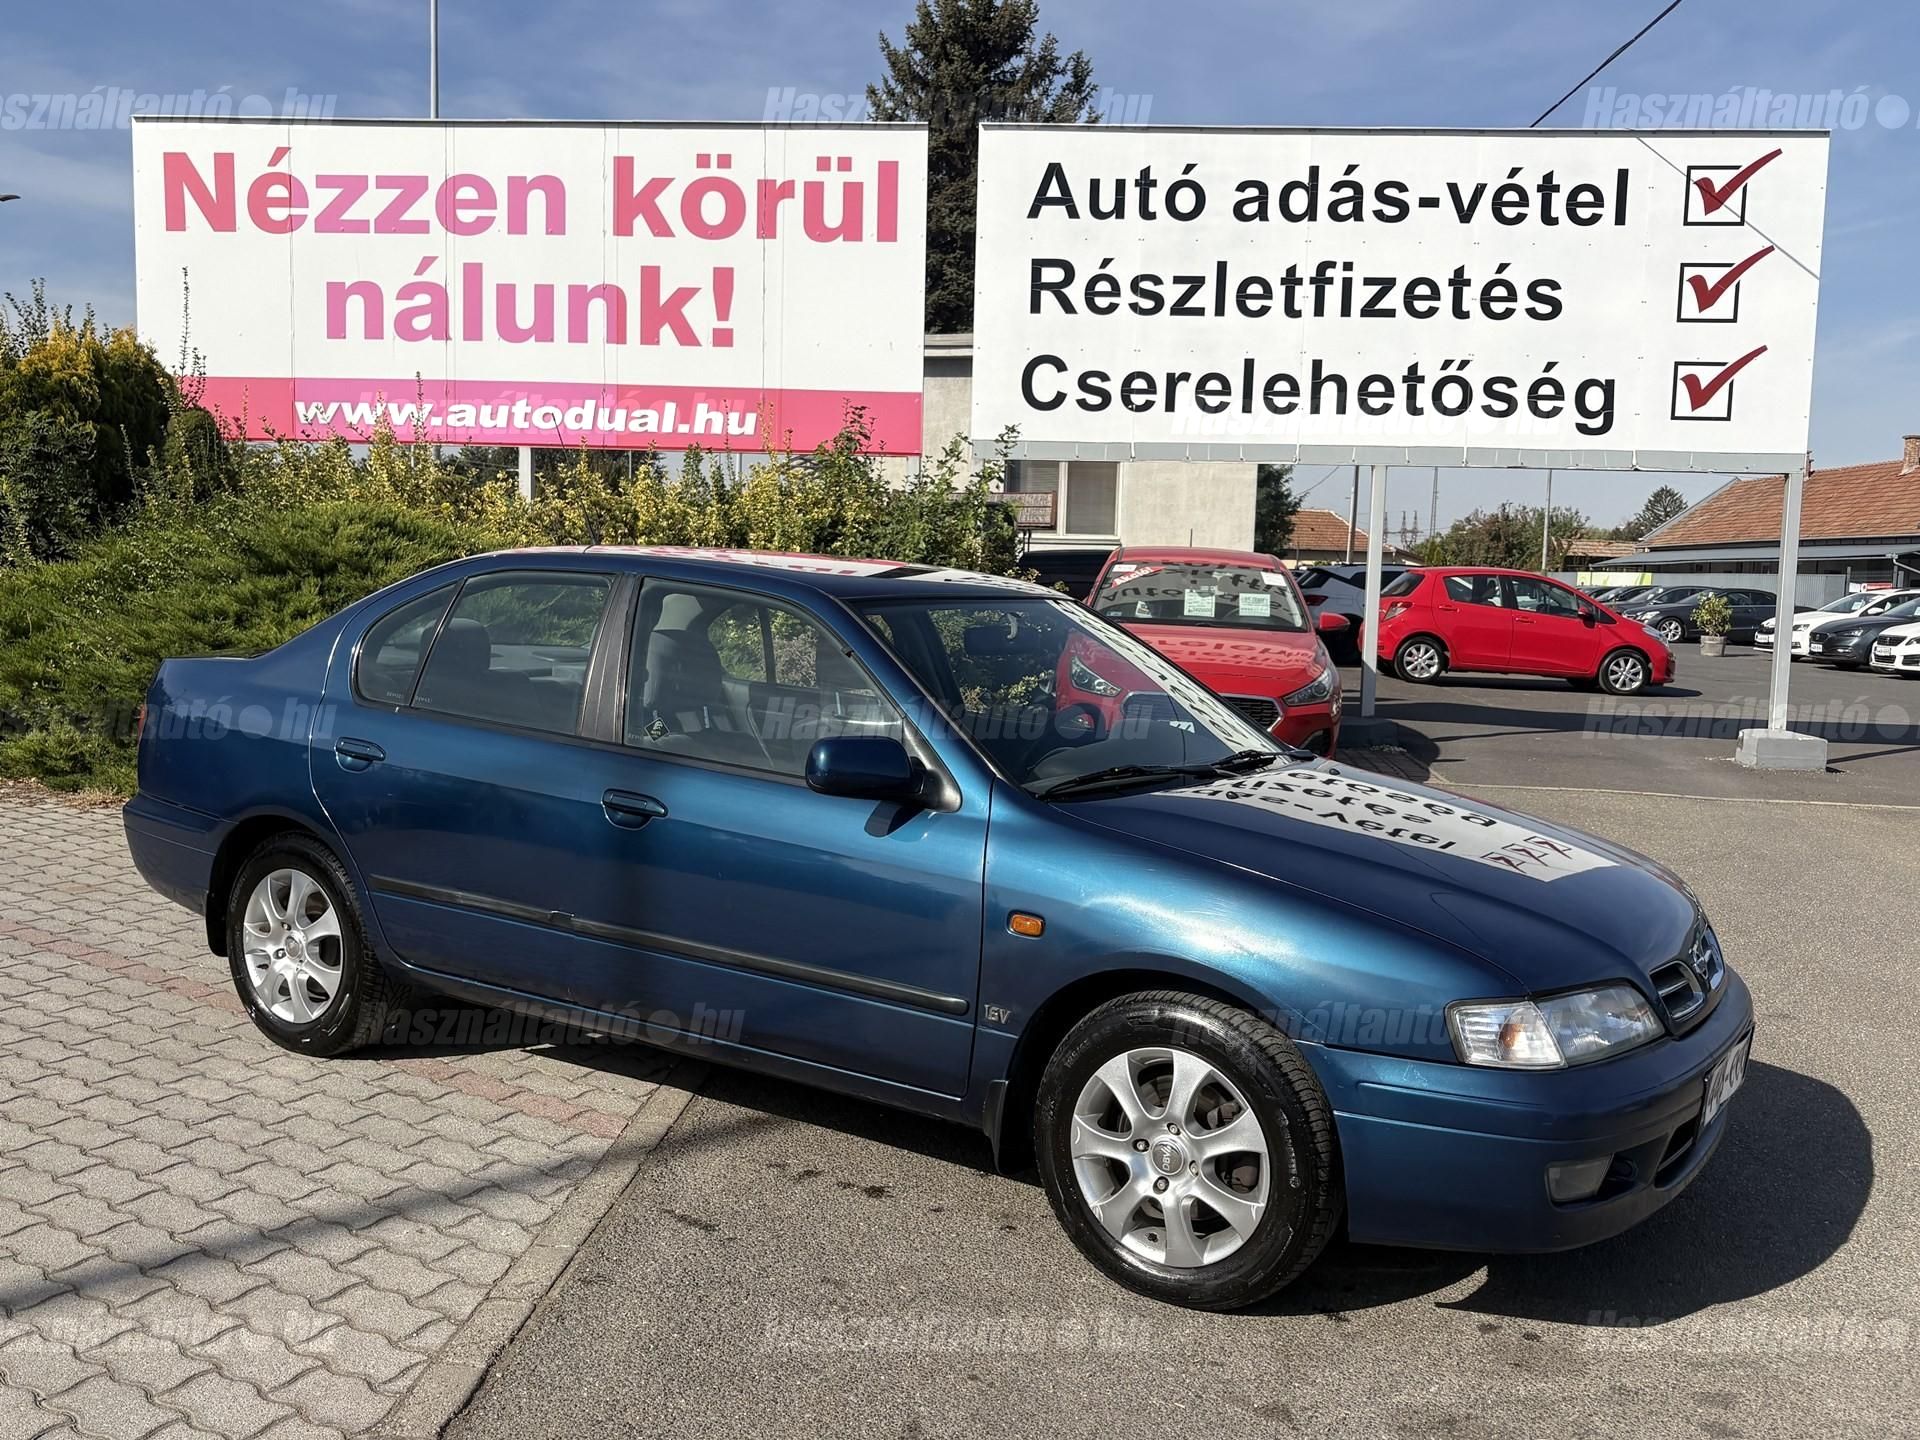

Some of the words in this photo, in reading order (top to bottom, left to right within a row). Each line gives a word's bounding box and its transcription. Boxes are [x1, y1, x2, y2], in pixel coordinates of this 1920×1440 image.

[163, 147, 566, 236] Nézzen
[613, 154, 898, 243] körül
[1027, 163, 1205, 221] Autó
[1233, 165, 1629, 226] adás-vétel
[326, 256, 734, 348] nálunk!
[1031, 258, 1563, 321] Részletfizetés
[295, 398, 758, 436] www.autodual.hu
[1022, 355, 1615, 435] Cserelehetőség
